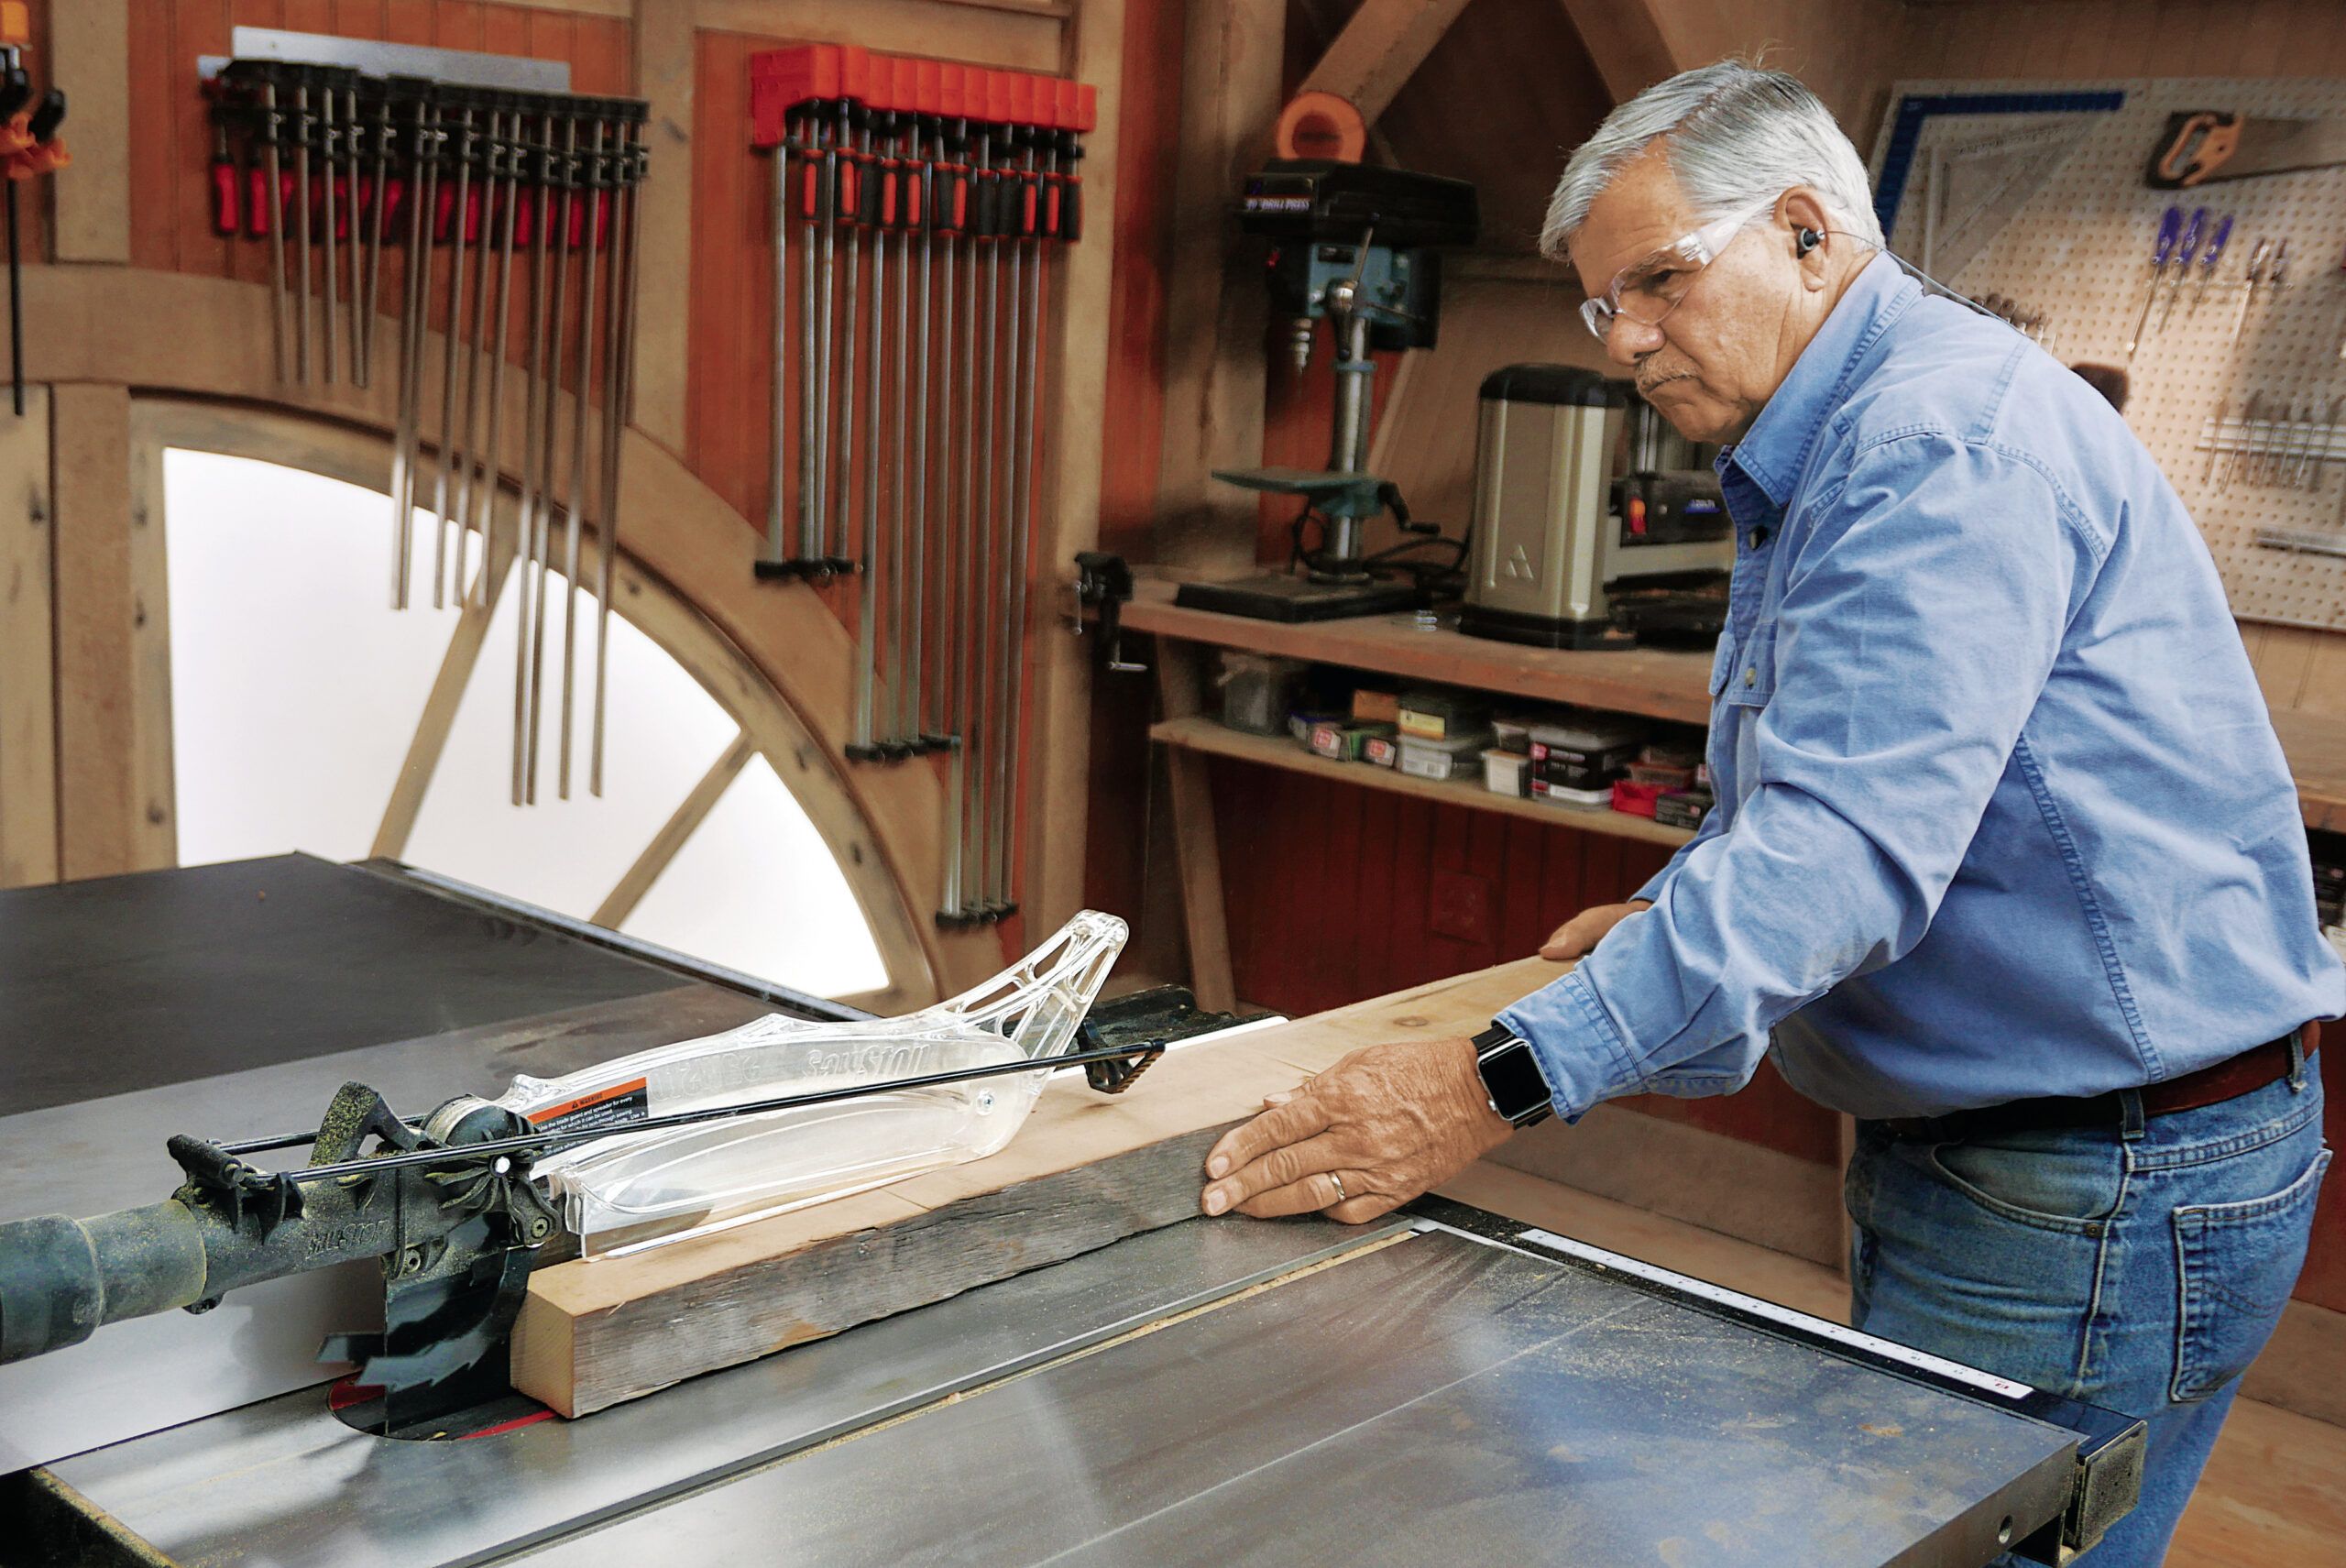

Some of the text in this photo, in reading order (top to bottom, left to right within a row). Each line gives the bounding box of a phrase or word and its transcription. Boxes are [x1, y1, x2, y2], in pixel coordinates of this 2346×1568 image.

[556, 1116, 569, 1125] blade
[570, 1112, 583, 1122] guard
[593, 1102, 613, 1113] spreader
[619, 1096, 632, 1104] every
